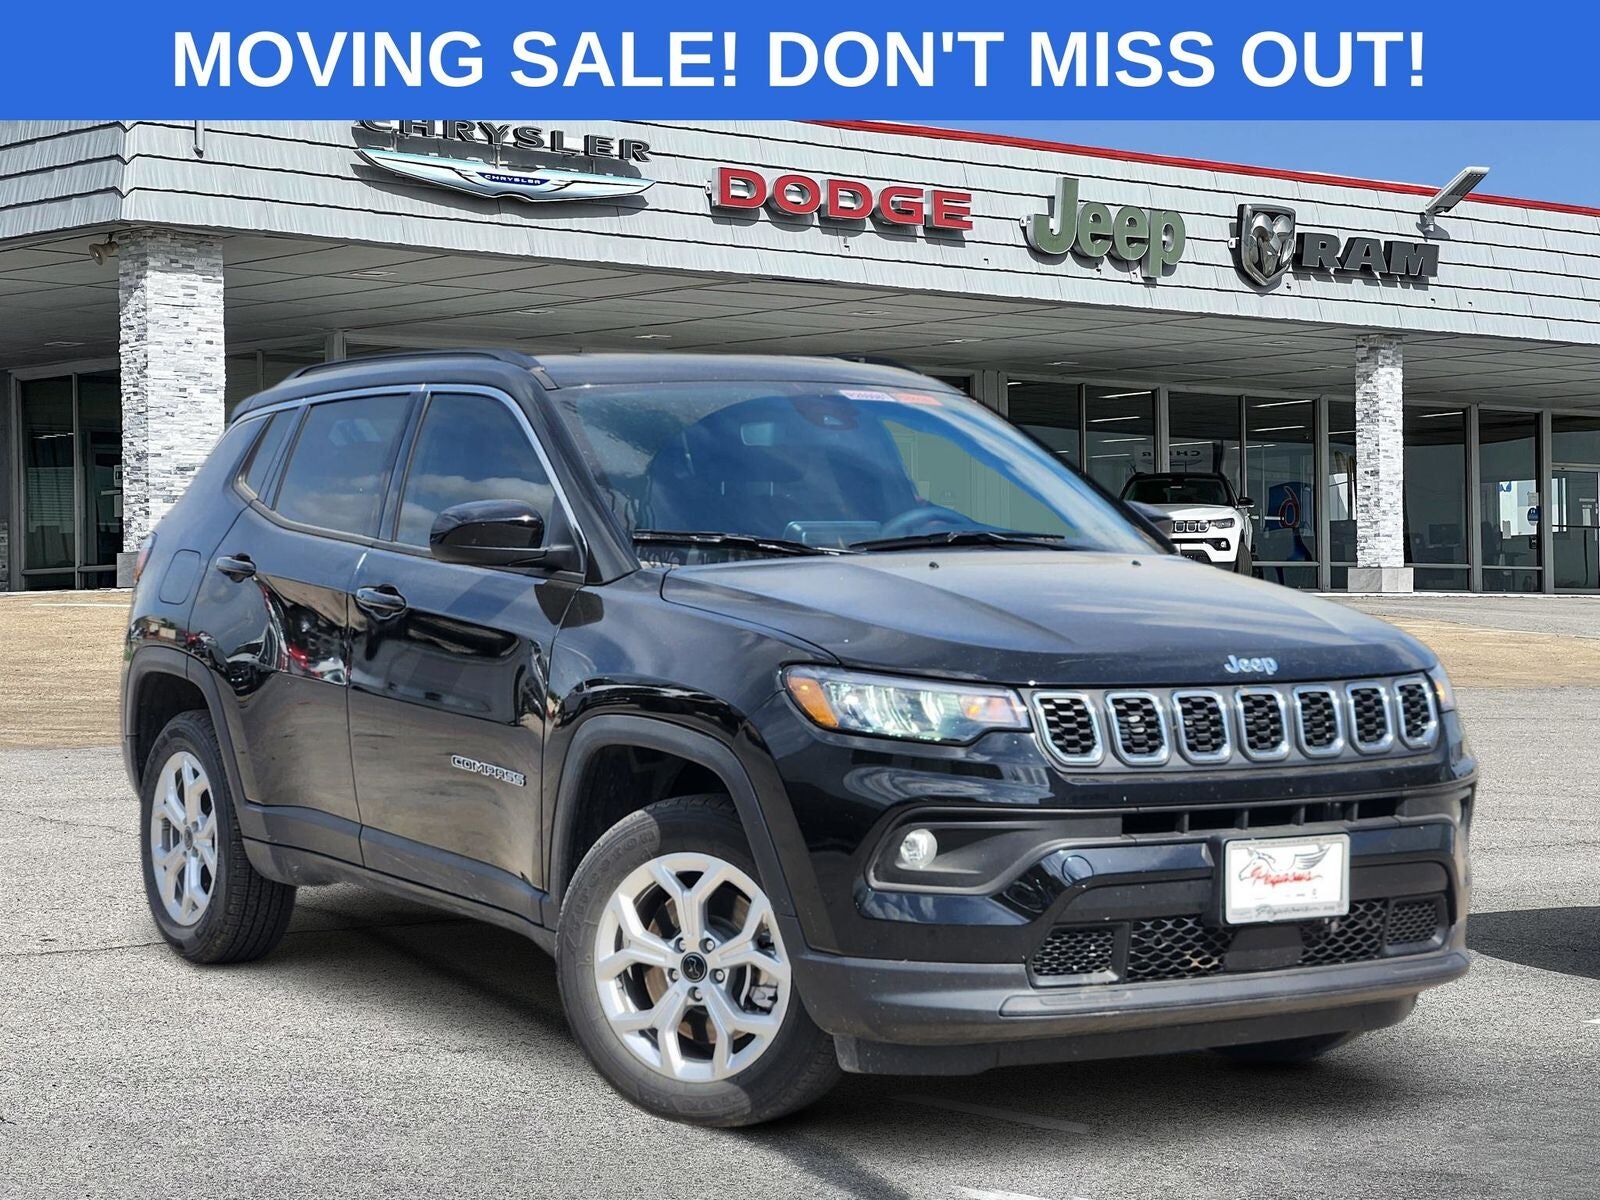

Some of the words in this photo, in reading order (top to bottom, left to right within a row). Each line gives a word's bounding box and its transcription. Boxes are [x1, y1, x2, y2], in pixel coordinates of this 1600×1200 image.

[484, 174, 542, 185] CHRYSLER
[714, 167, 974, 230] DODGE
[1027, 177, 1187, 278] Jeep
[1299, 232, 1440, 278] RAM
[1223, 654, 1279, 676] Jeep
[450, 754, 526, 787] COMPASS
